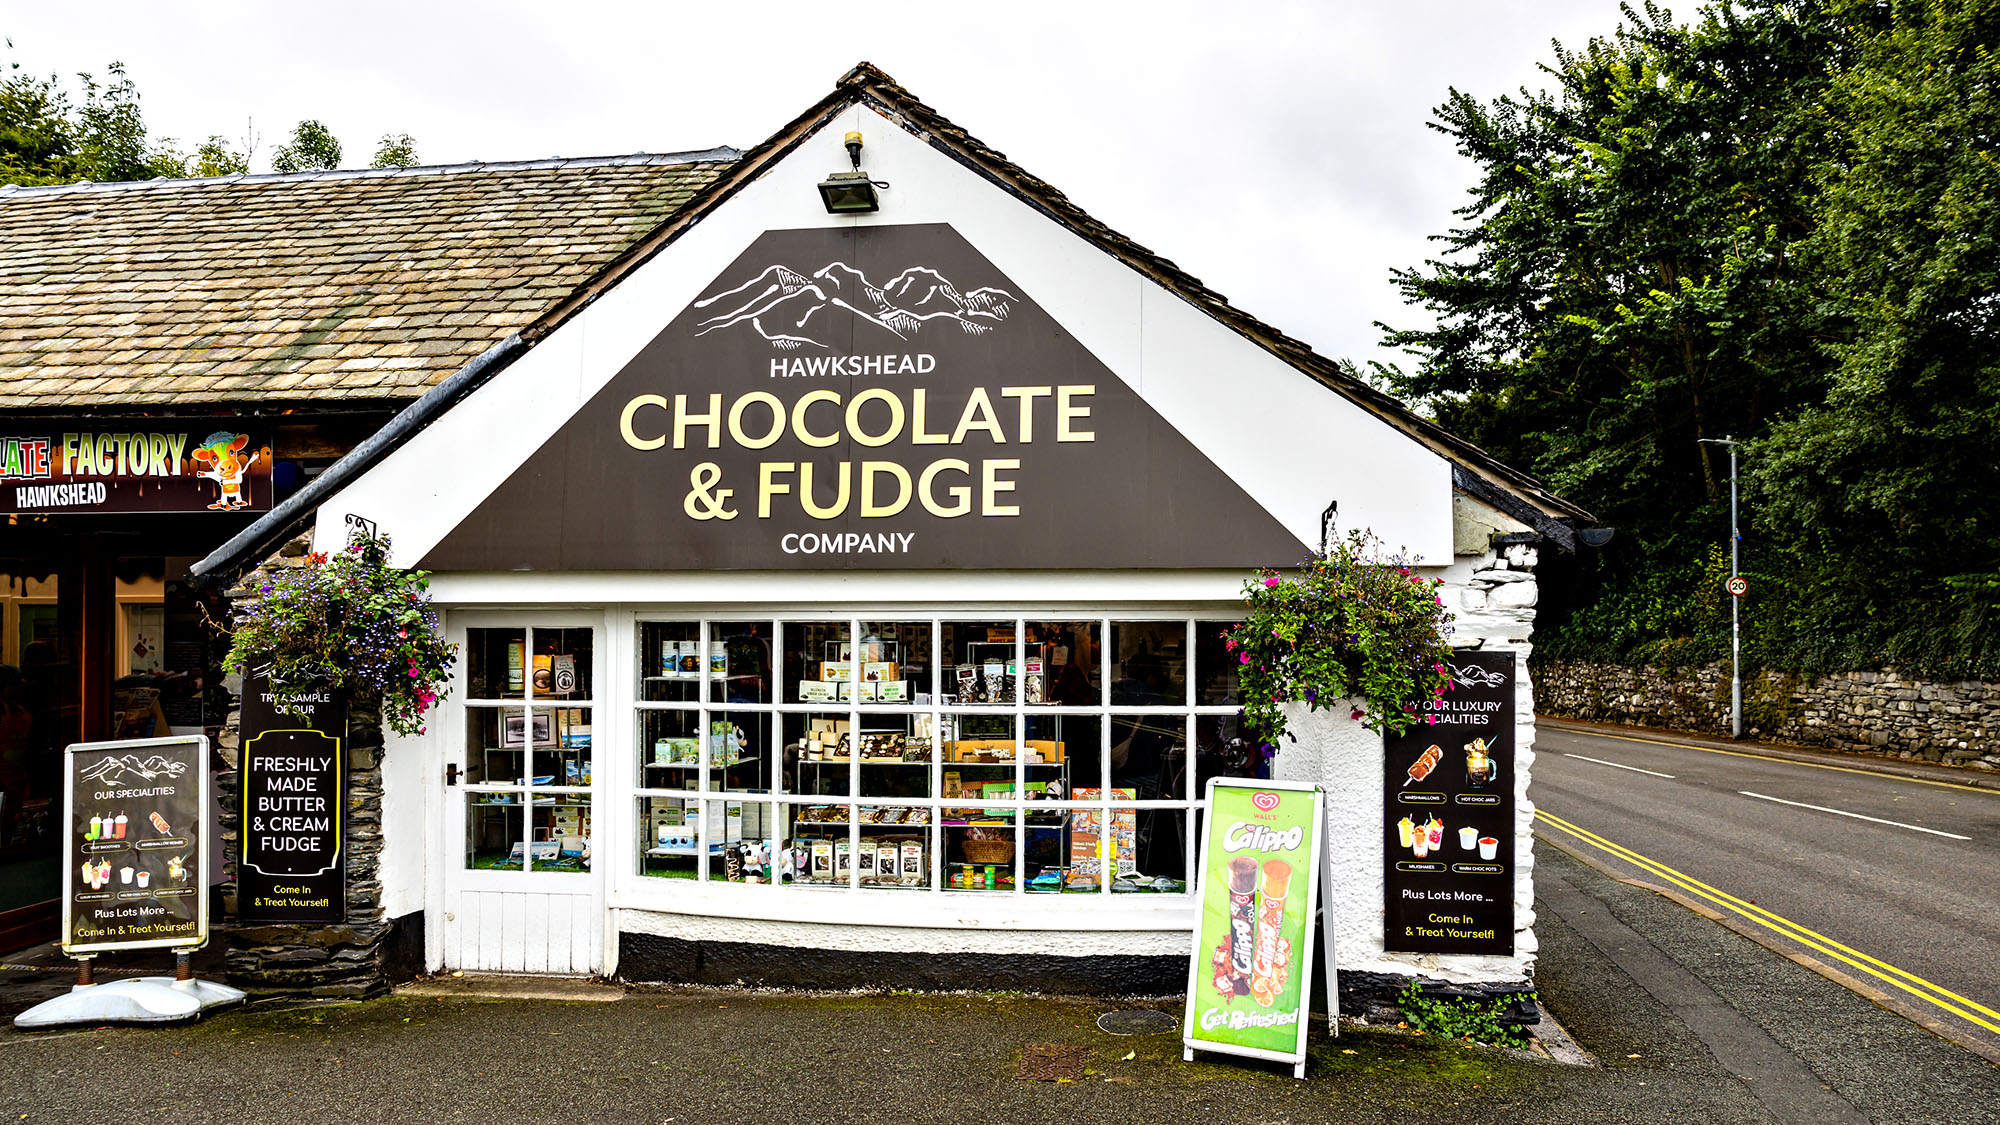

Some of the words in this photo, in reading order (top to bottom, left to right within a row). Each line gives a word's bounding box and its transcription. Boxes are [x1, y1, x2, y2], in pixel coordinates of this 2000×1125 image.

[769, 353, 936, 378] HAWKSHEAD
[619, 384, 1096, 451] CHOCOLATE
[62, 433, 188, 477] FACTORY
[16, 482, 107, 508] HAWKSHEAD
[683, 462, 739, 521] &
[757, 458, 1021, 519] FUDGE
[780, 532, 916, 555] COMPANY
[1731, 582, 1745, 591] 20
[290, 693, 331, 703] SAMPLE
[1452, 701, 1502, 712] LUXURY
[253, 757, 331, 772] FRESHLY
[267, 777, 317, 792] MADE
[94, 790, 115, 800] OUR
[115, 786, 176, 798] SPECIALITIES
[258, 797, 326, 812] BUTTER
[253, 817, 265, 832] &
[269, 817, 329, 832] CREAM
[1253, 813, 1277, 821] WALL'S
[261, 837, 321, 852] FUDGE
[1222, 821, 1303, 853] Calippo
[273, 885, 300, 895] Come
[302, 885, 312, 894] In
[1402, 889, 1425, 900] Plus
[1427, 890, 1452, 901] Lots
[1454, 891, 1483, 902] More
[254, 898, 262, 907] &
[264, 898, 287, 907] Treat
[289, 897, 329, 908] Yourself!
[94, 909, 115, 919] Plus
[116, 908, 138, 918] Lots
[139, 907, 165, 917] More
[1247, 901, 1255, 923] COLA
[1428, 913, 1459, 924] Come
[1462, 914, 1474, 924] In
[77, 927, 105, 938] Come
[106, 926, 116, 936] In
[117, 925, 126, 935] &
[127, 924, 152, 934] Treat
[153, 921, 196, 935] Yourself!
[1405, 926, 1414, 937] &
[1416, 926, 1445, 938] Treat
[1446, 927, 1495, 940] Yourself!
[1231, 918, 1253, 975] Calippo
[1253, 921, 1277, 978] Calippo
[1200, 1007, 1229, 1032] Get
[1227, 1007, 1299, 1031] Refreshed
